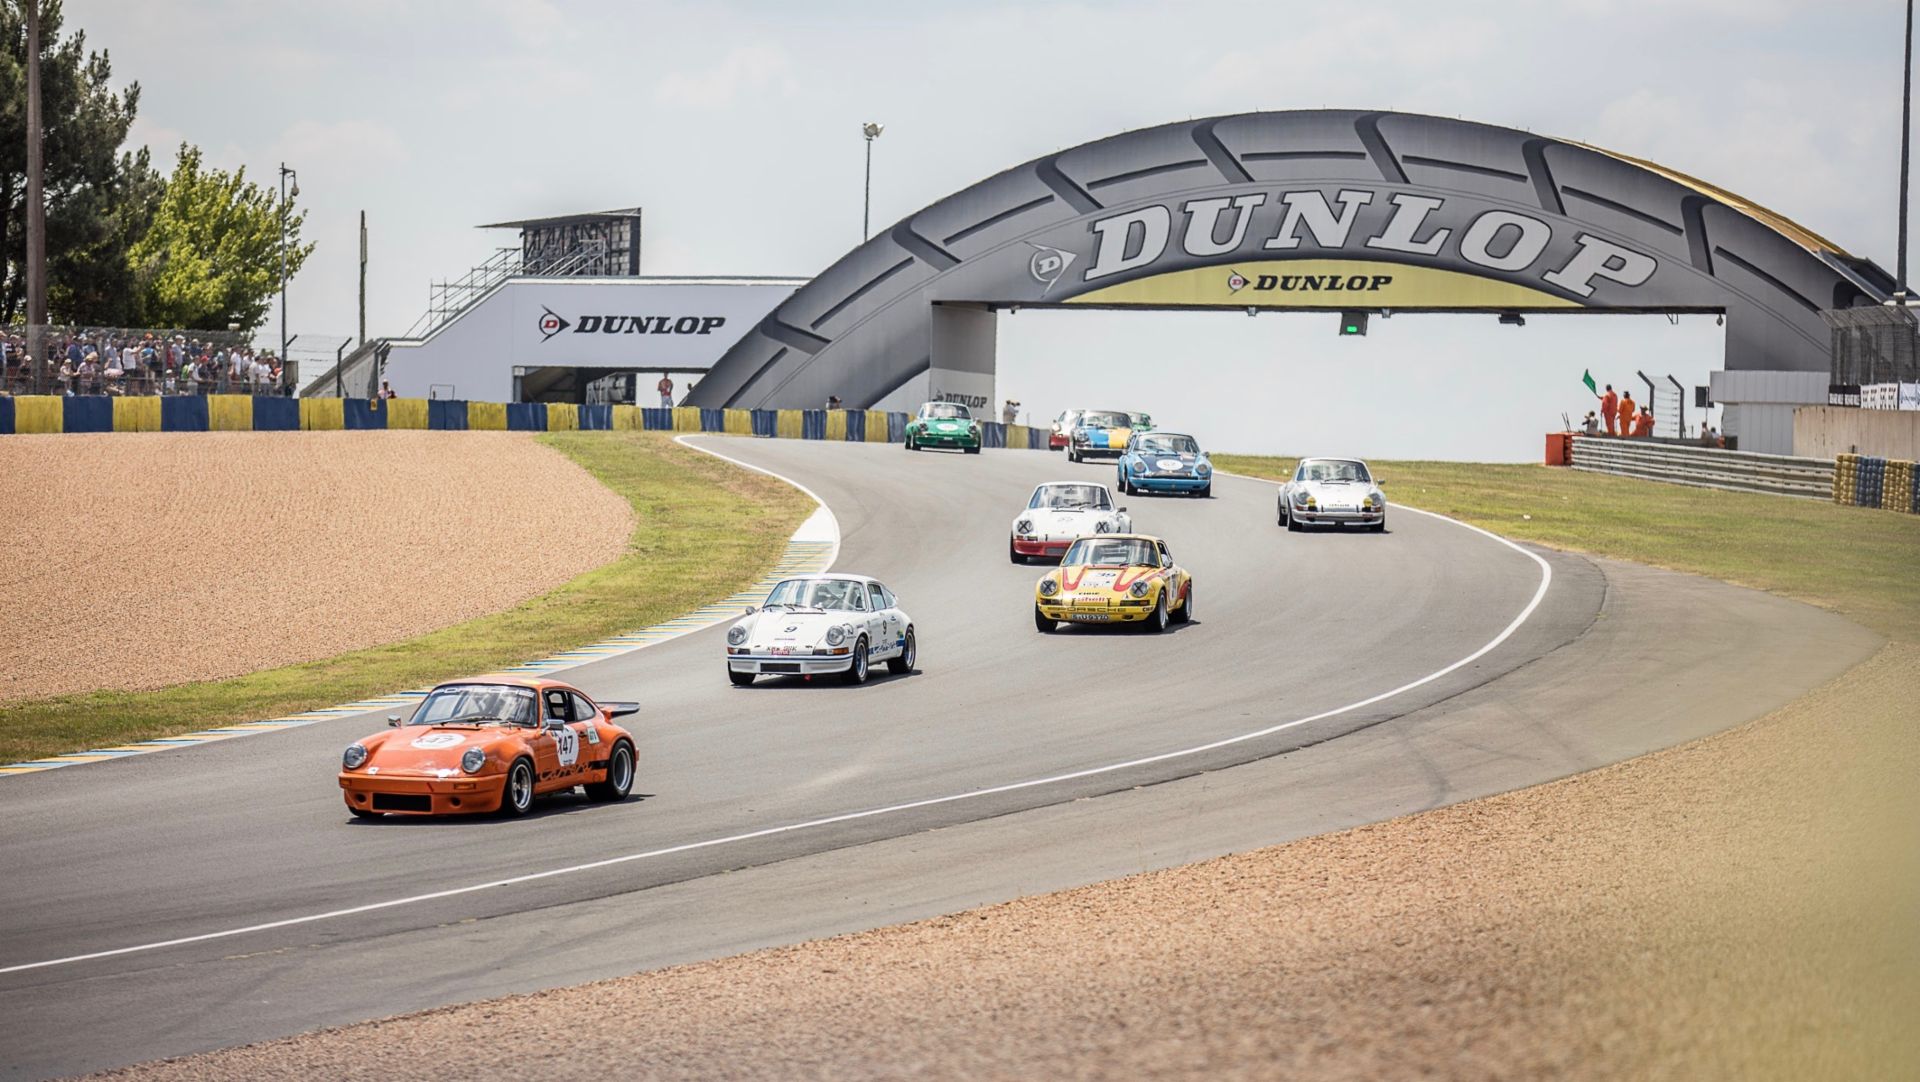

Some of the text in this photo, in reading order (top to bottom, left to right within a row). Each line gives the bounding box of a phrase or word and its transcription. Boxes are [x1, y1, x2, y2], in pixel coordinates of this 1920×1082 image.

[1083, 188, 1658, 298] DUNLOP
[1253, 275, 1392, 291] DUNLOP
[573, 315, 726, 334] DUNLOP
[945, 393, 988, 408] DUNLOP
[882, 620, 888, 635] 9
